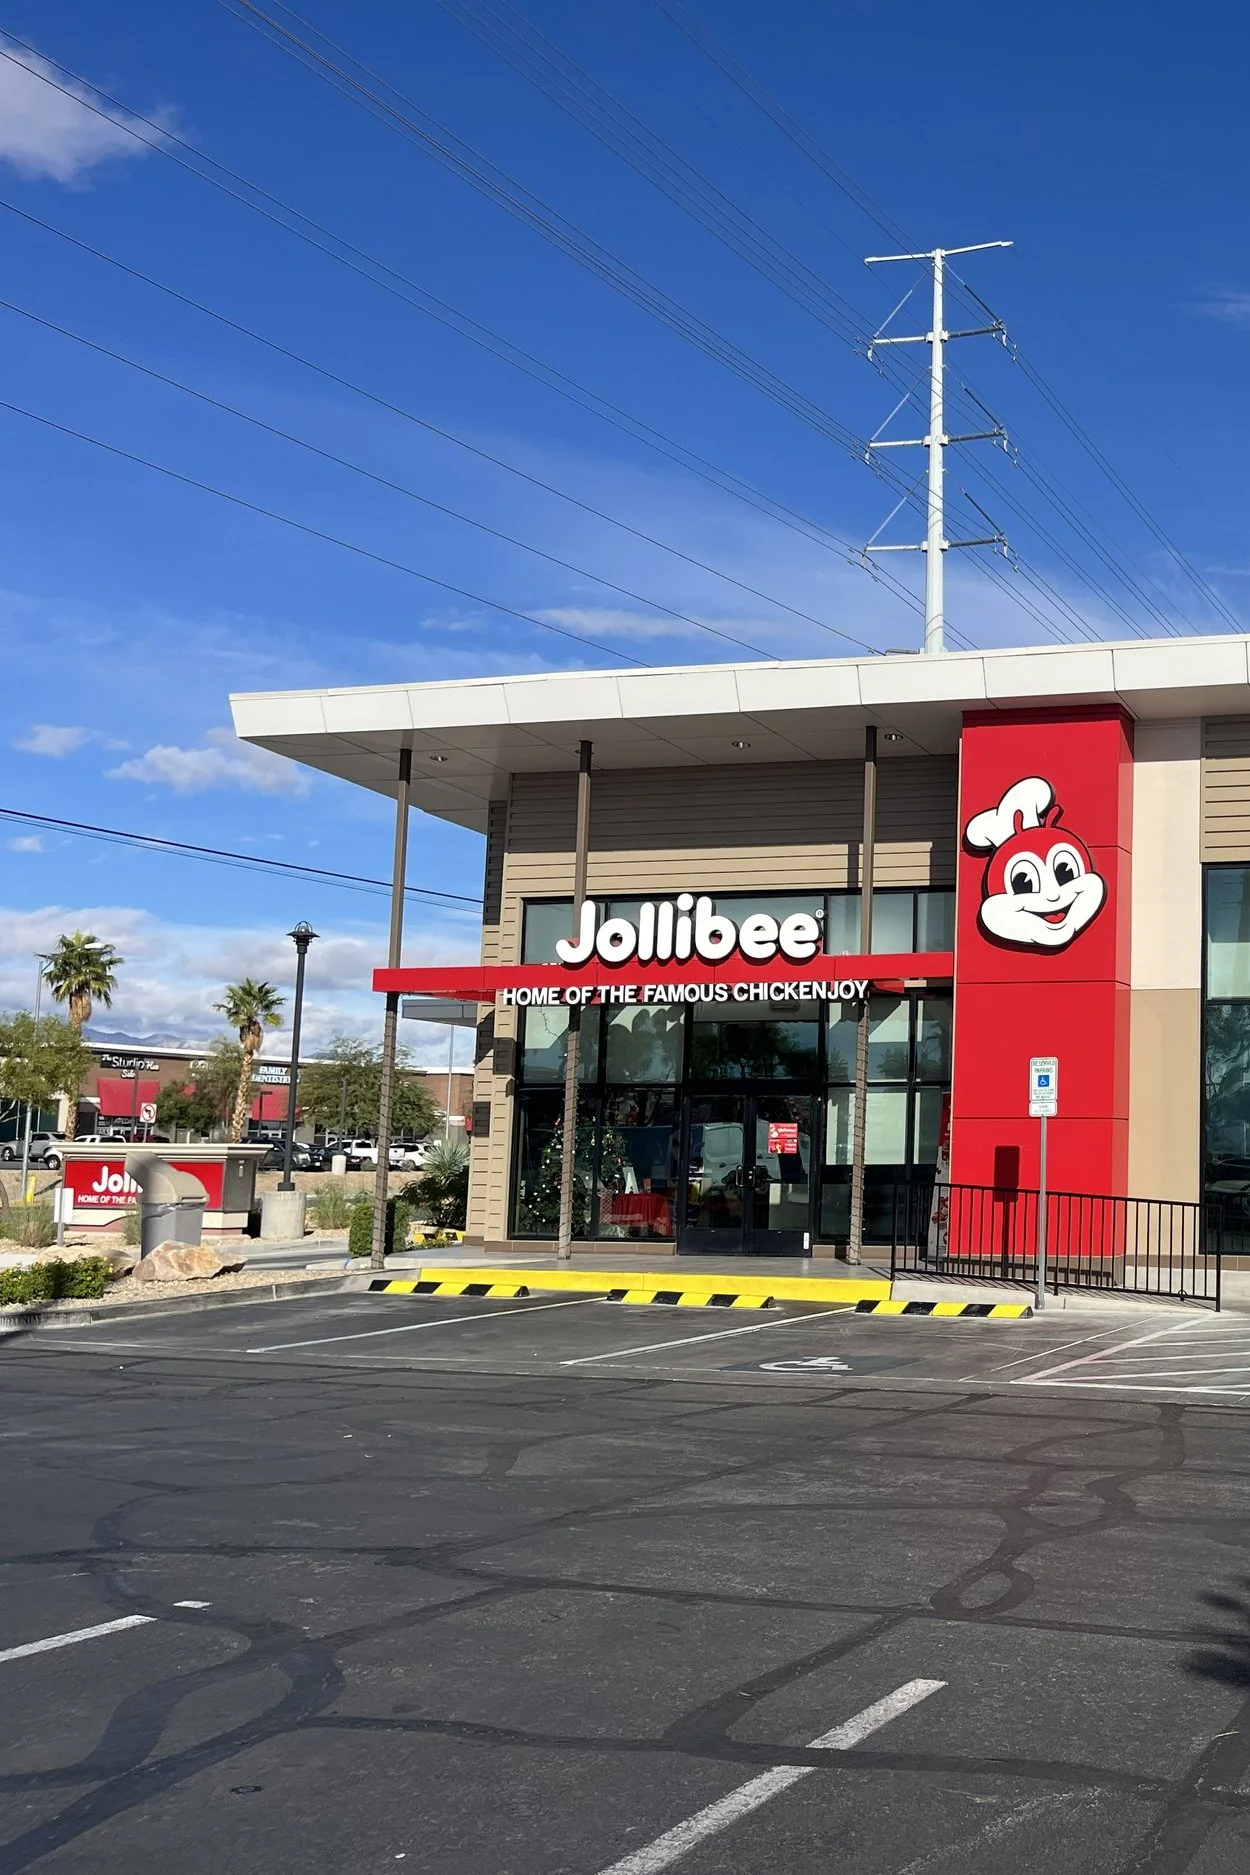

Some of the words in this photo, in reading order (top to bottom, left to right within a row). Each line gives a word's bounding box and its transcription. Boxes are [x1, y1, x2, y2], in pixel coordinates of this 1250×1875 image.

[556, 893, 819, 963] Jollibee
[503, 987, 560, 1005] HOME
[565, 986, 593, 1005] OF
[598, 985, 637, 1004] THE
[644, 983, 728, 1003] FAMOUS
[733, 979, 868, 1002] CHICKENJOY
[259, 1066, 287, 1075] FAMILY
[78, 1194, 99, 1204] HOME
[100, 1195, 111, 1204] OF
[112, 1196, 126, 1205] THE
